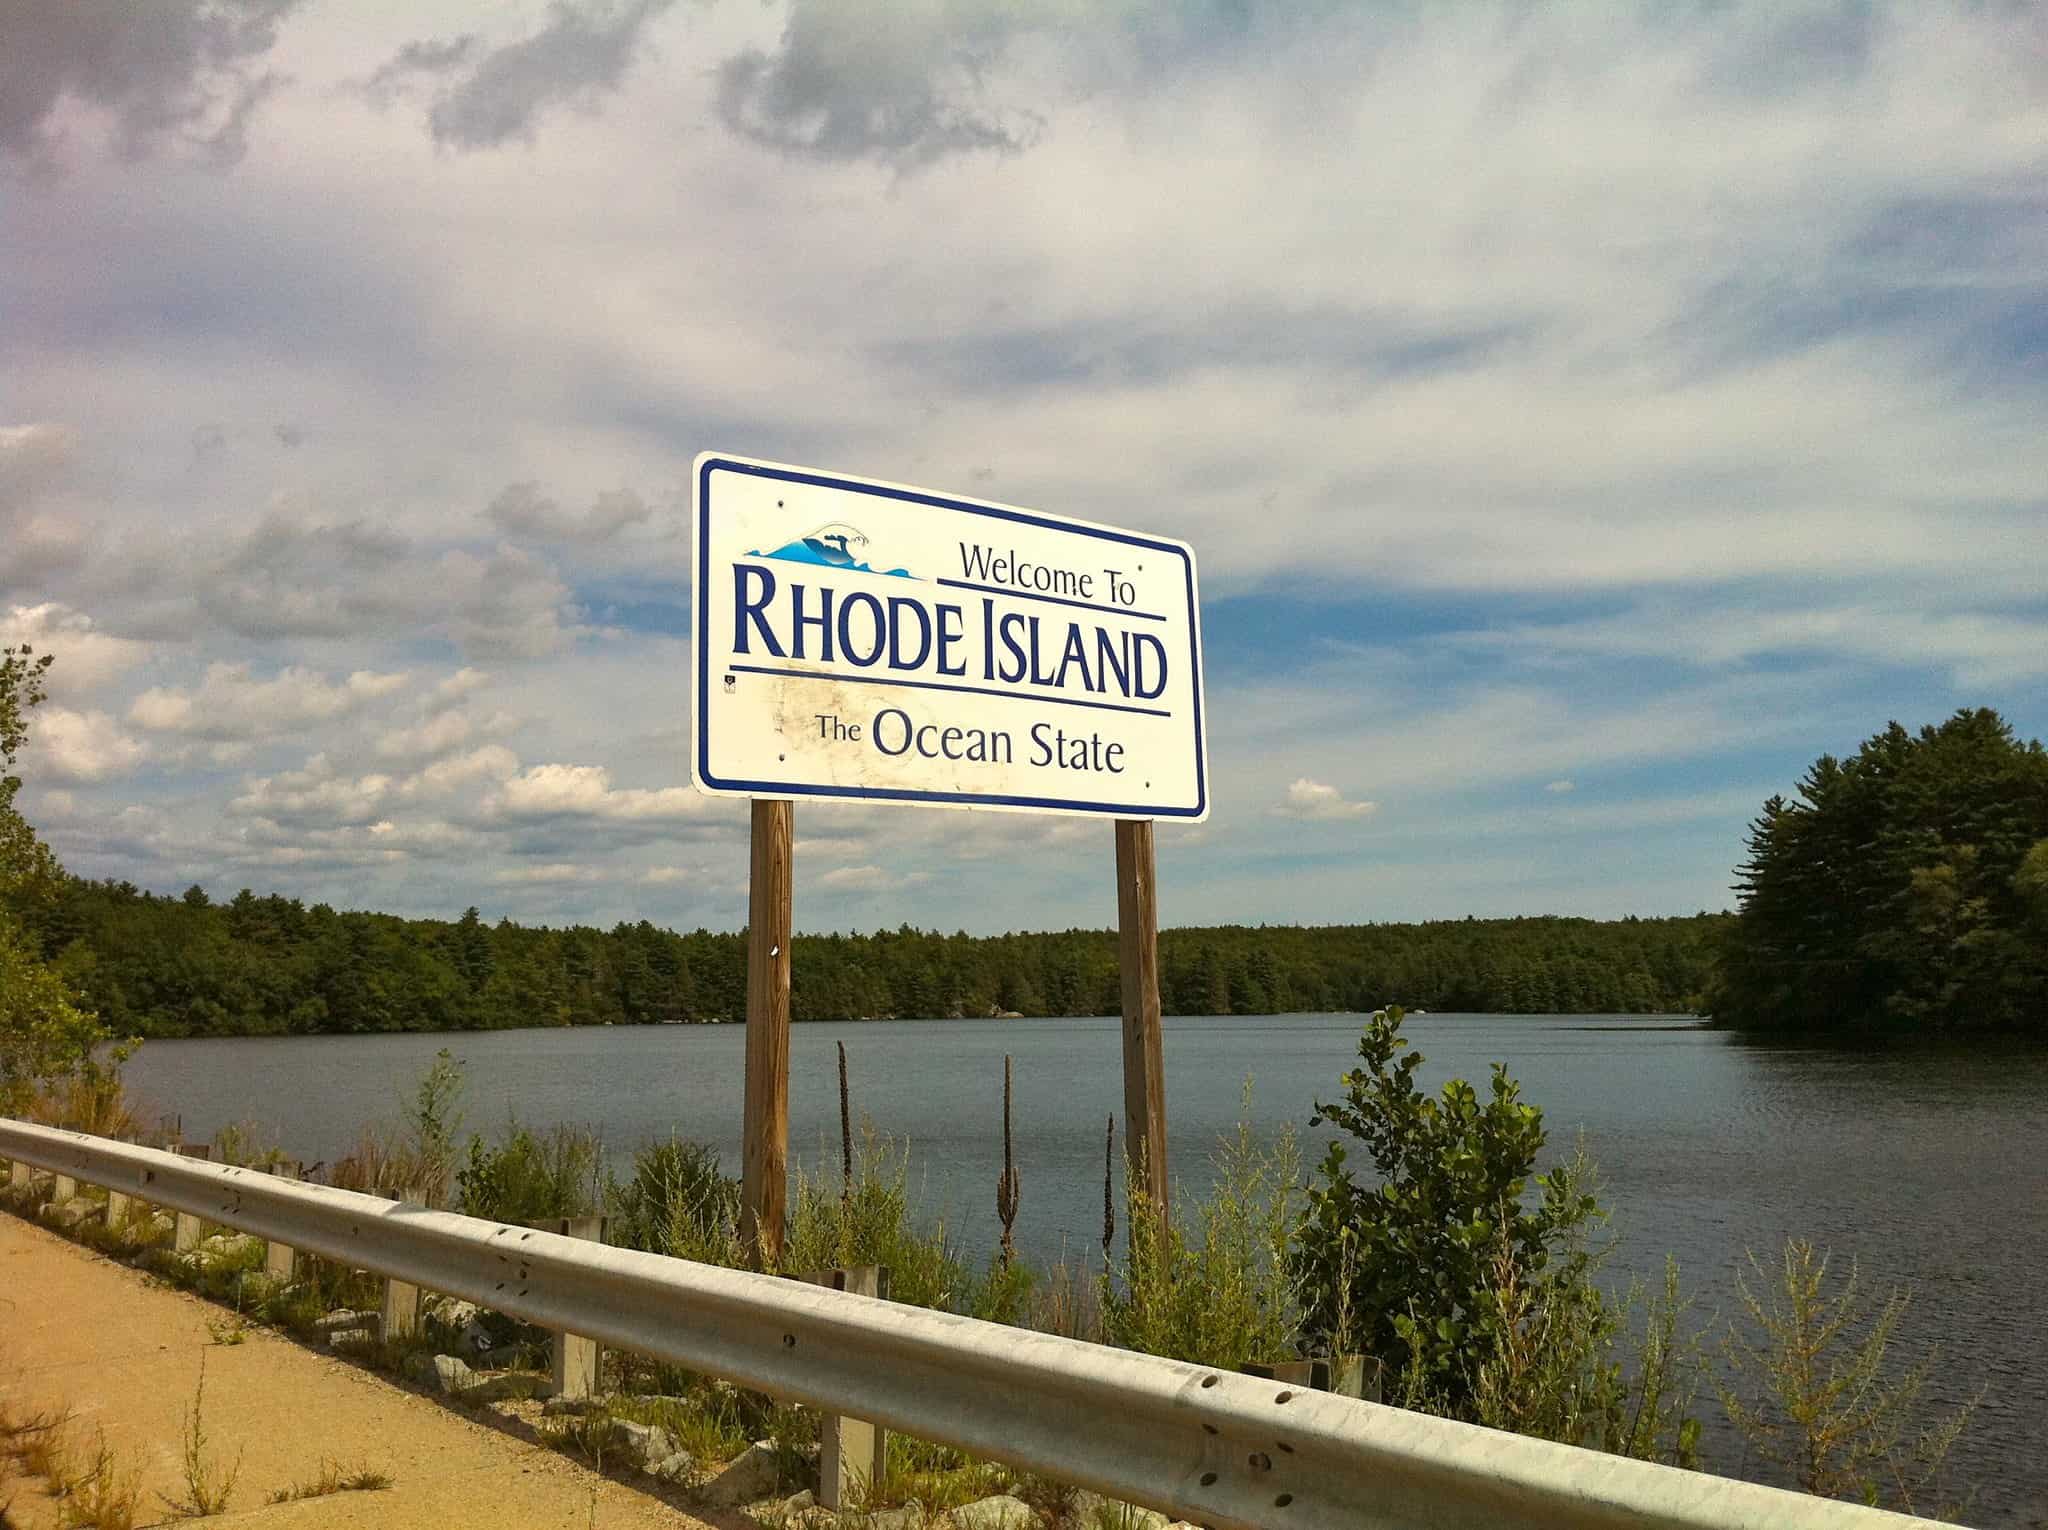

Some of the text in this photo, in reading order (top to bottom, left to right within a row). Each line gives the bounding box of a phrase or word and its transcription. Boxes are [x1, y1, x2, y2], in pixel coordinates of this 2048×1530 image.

[959, 542, 1136, 607] Welcome To
[732, 563, 1169, 700] RHODE ISLAND
[815, 708, 1125, 773] The Ocean State
